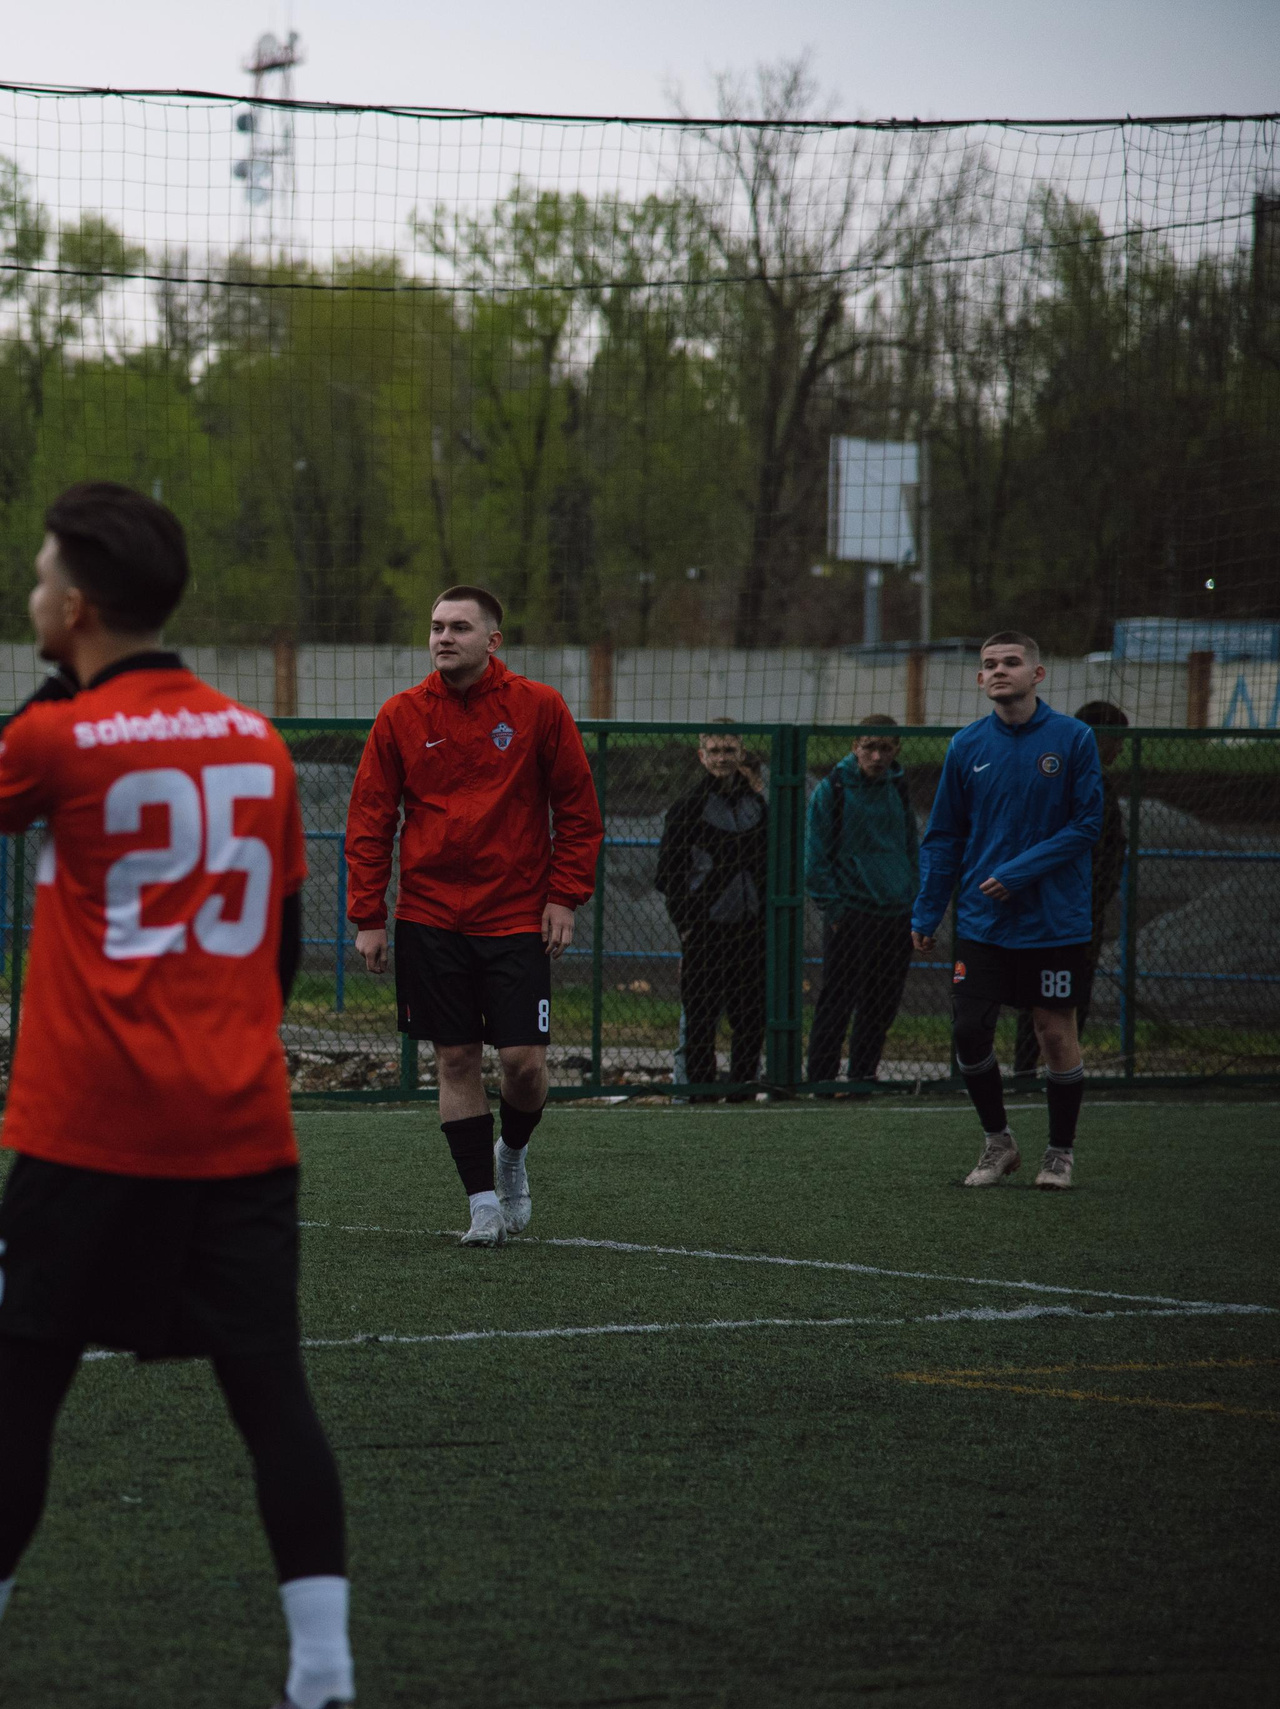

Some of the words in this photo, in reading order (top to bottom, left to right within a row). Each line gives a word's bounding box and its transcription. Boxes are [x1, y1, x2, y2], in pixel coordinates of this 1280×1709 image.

[103, 762, 275, 961] 25
[1040, 969, 1072, 998] 88
[538, 998, 550, 1033] 8
